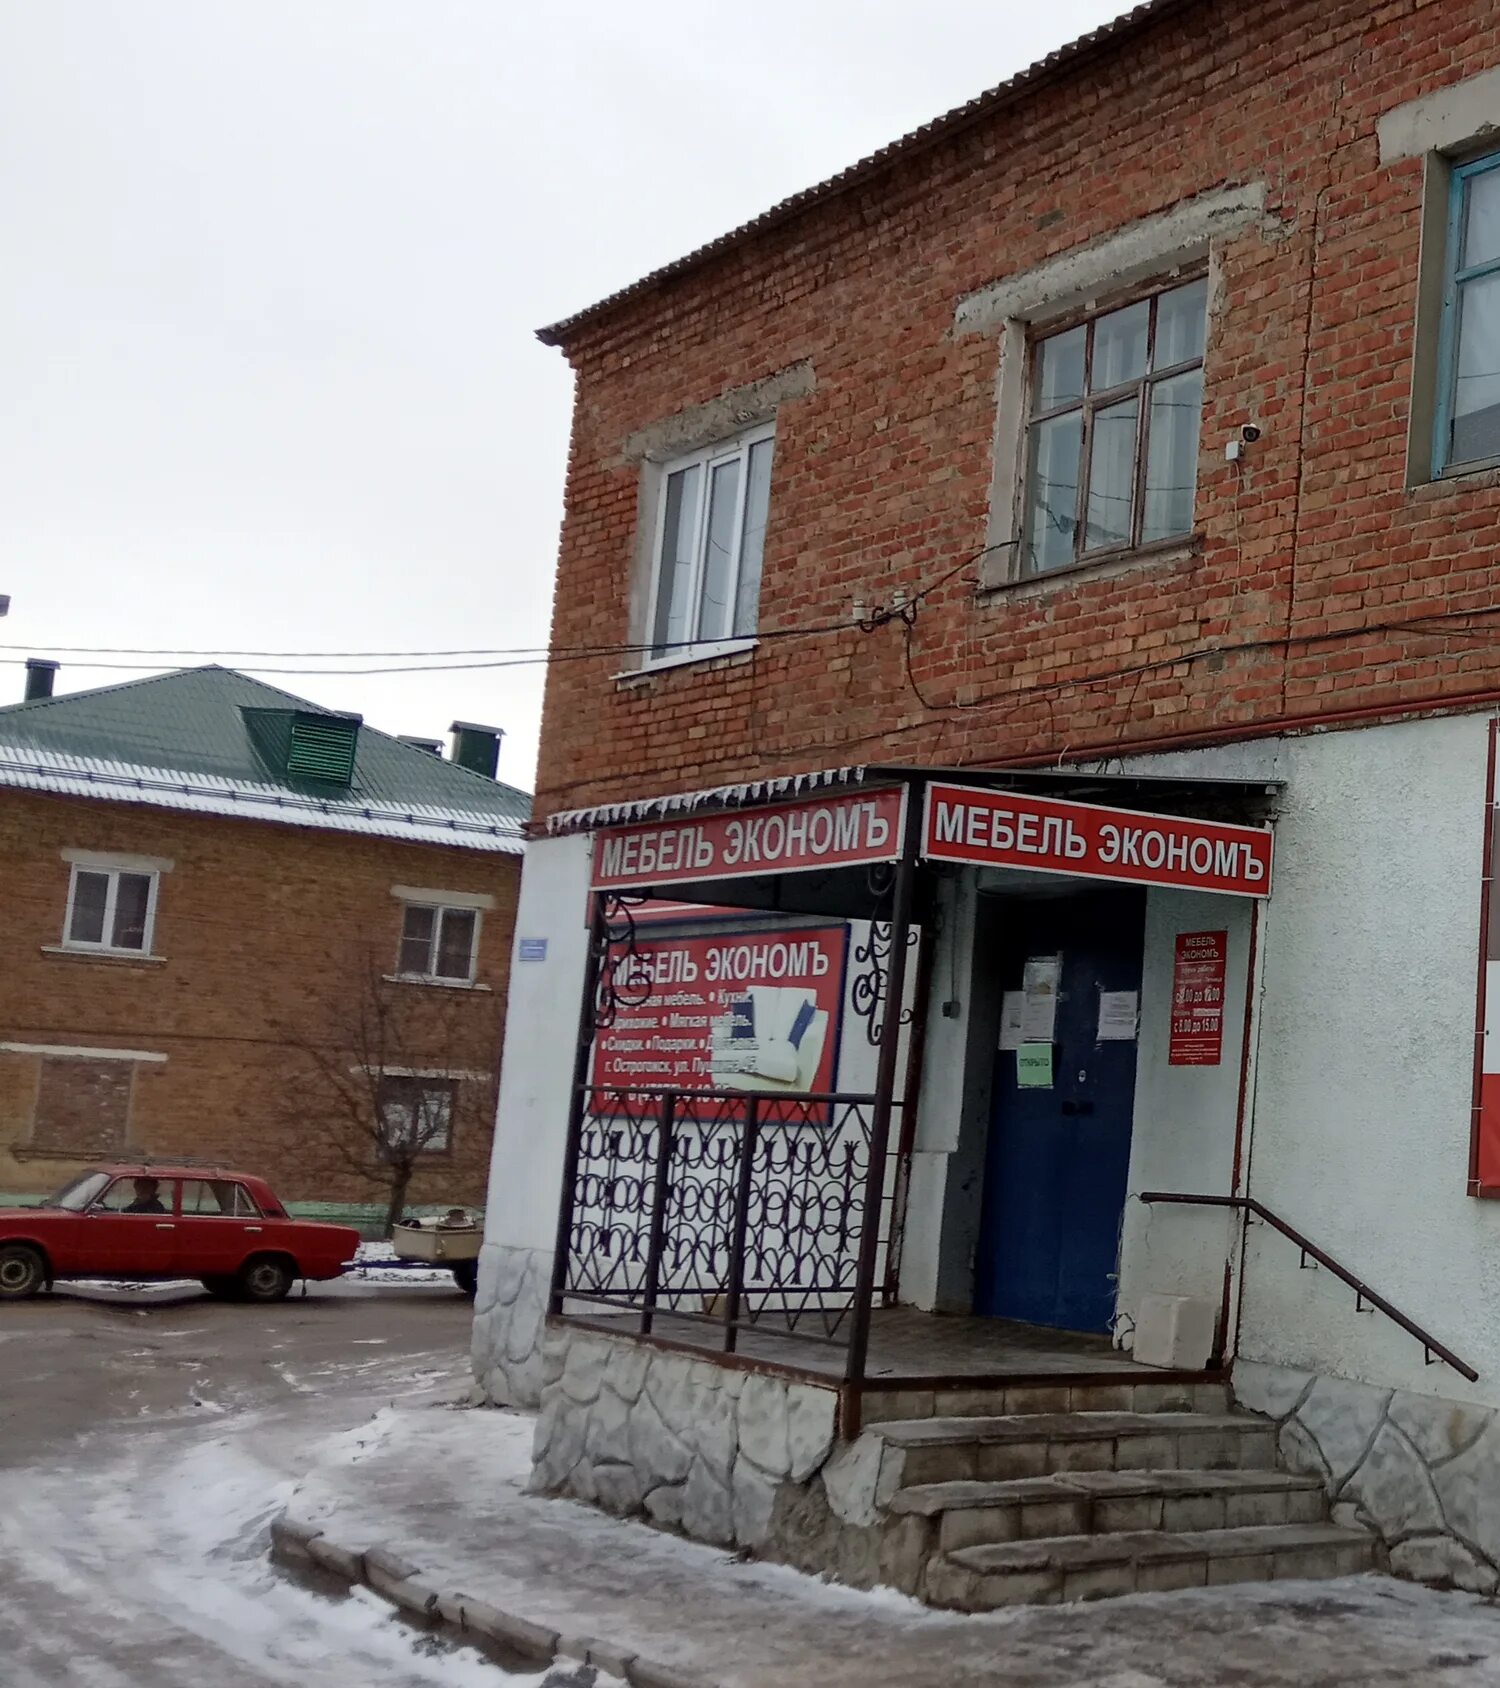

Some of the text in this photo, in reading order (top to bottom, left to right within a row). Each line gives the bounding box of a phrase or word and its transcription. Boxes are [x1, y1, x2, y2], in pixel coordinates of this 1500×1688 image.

[600, 801, 890, 878] МЕБЕЛЬ ЭКОНОМЪ
[934, 801, 1265, 882] МЕБЕЛЬ ЭКОНОМЪ
[612, 940, 829, 986] МЕБЕЛЬ ЭКОНОМЪ
[1181, 948, 1219, 960] ЭКОНОМЪ
[1185, 936, 1216, 947] МЕБЕЛЬ
